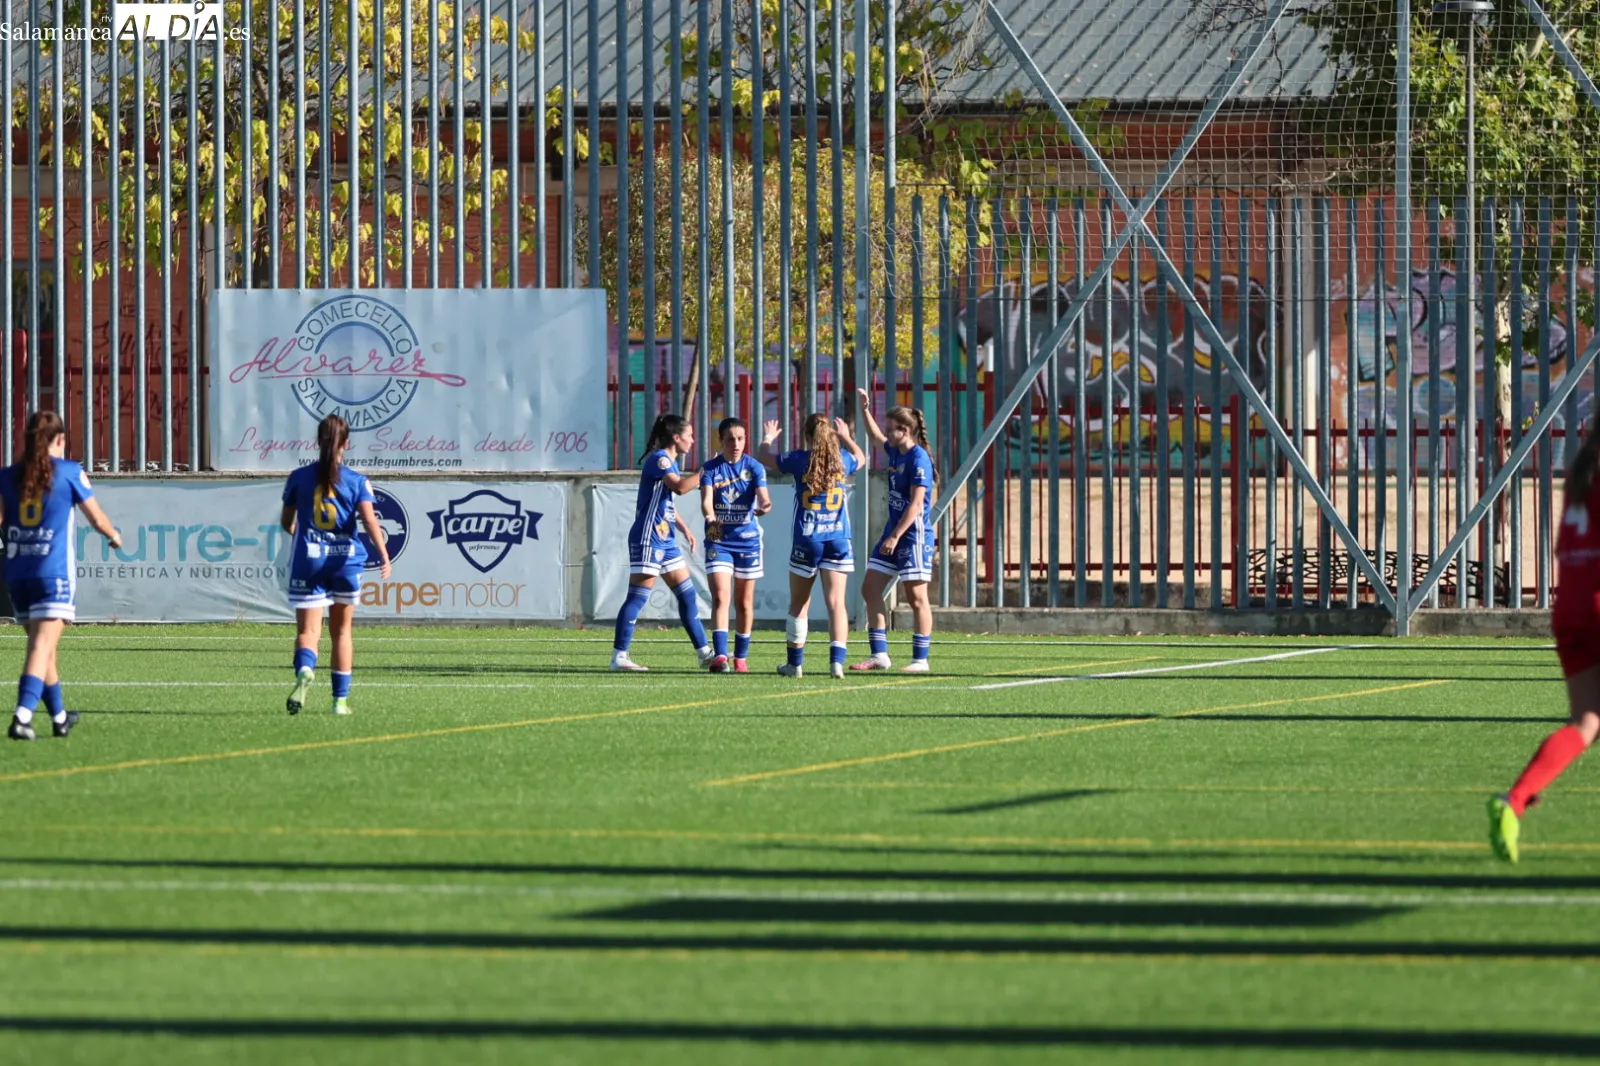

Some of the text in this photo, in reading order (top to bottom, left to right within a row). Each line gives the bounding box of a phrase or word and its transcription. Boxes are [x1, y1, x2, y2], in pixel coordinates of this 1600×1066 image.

[297, 300, 413, 355] GOMECELLO
[229, 337, 466, 387] Alvarez
[368, 426, 459, 452] Selectas
[474, 431, 536, 452] desde
[544, 430, 588, 453] 1906
[313, 484, 337, 530] 6
[802, 472, 844, 511] 26
[446, 515, 522, 540] carpe
[76, 564, 286, 579] DIETÉTICA Y NUTRICIÓN
[360, 576, 527, 614] arpemotor
